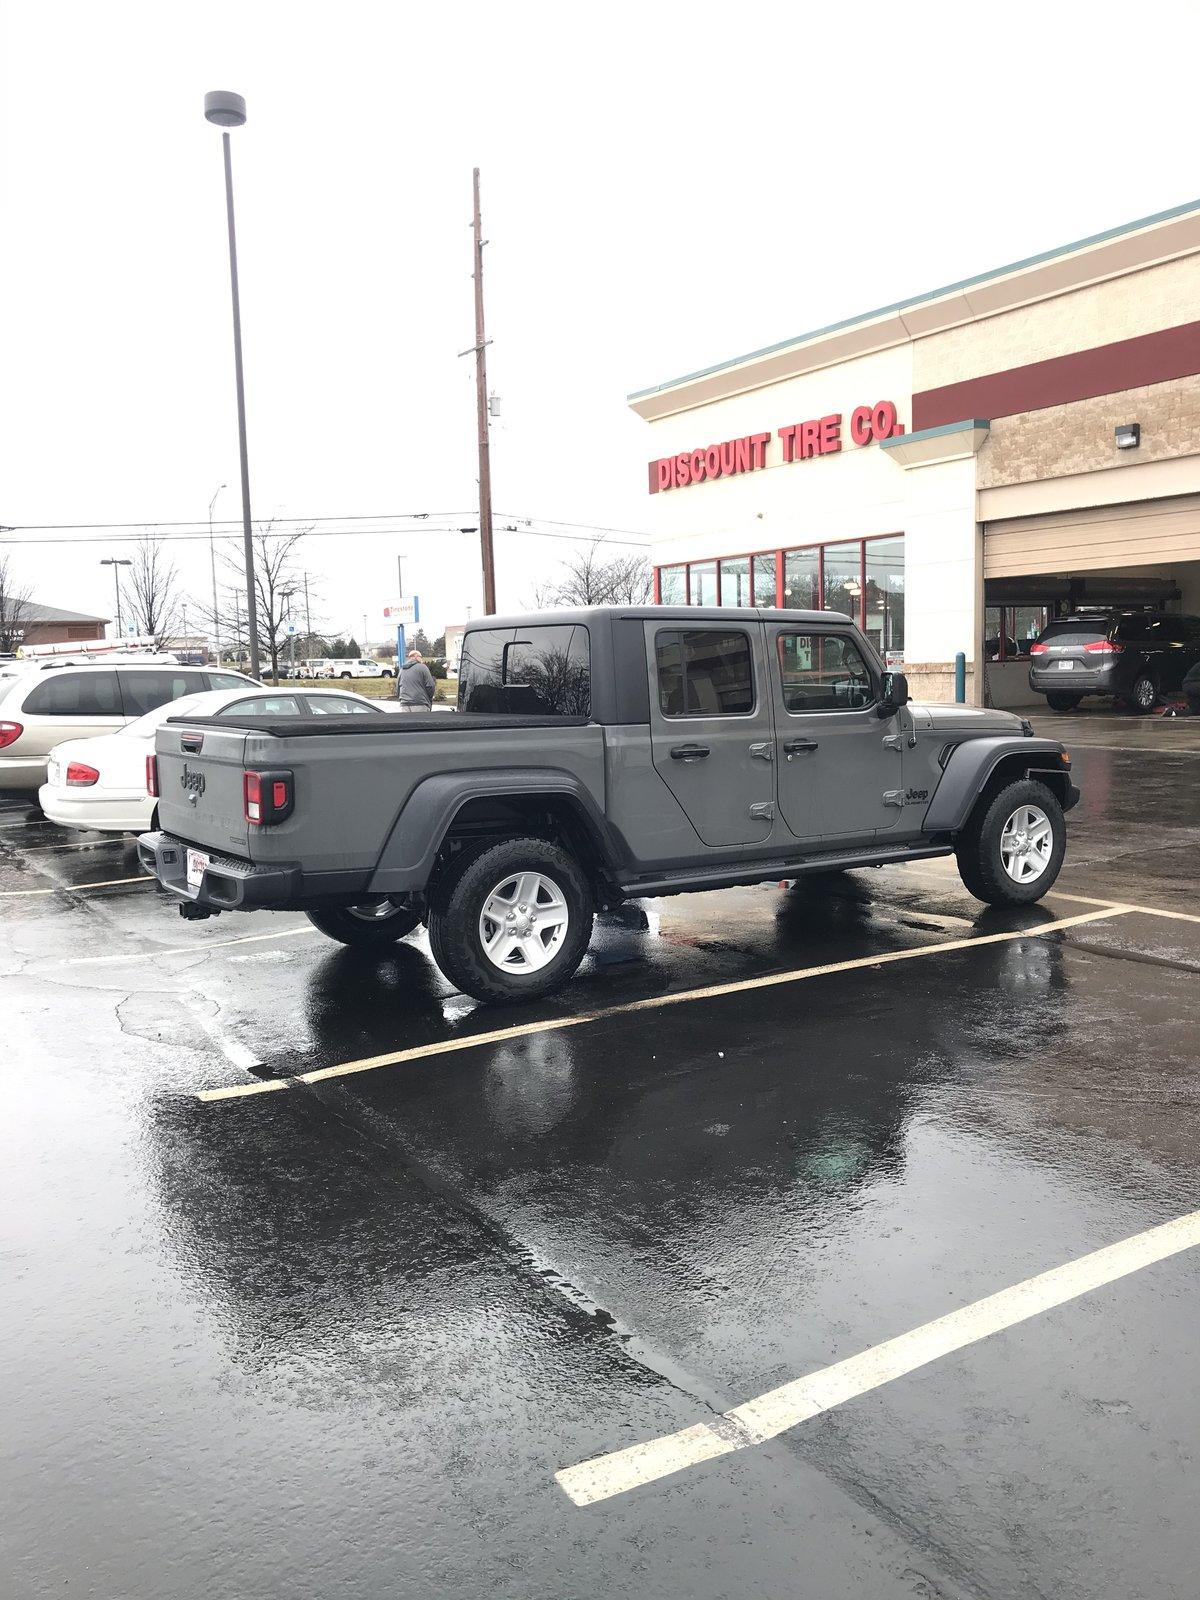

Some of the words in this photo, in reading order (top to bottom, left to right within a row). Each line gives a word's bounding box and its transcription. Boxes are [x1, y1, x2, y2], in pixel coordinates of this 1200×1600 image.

[658, 432, 771, 490] DISCOUNT
[778, 413, 842, 462] TIRE
[851, 400, 905, 446] CO.
[181, 763, 206, 798] Jeep
[906, 788, 928, 800] Jeep
